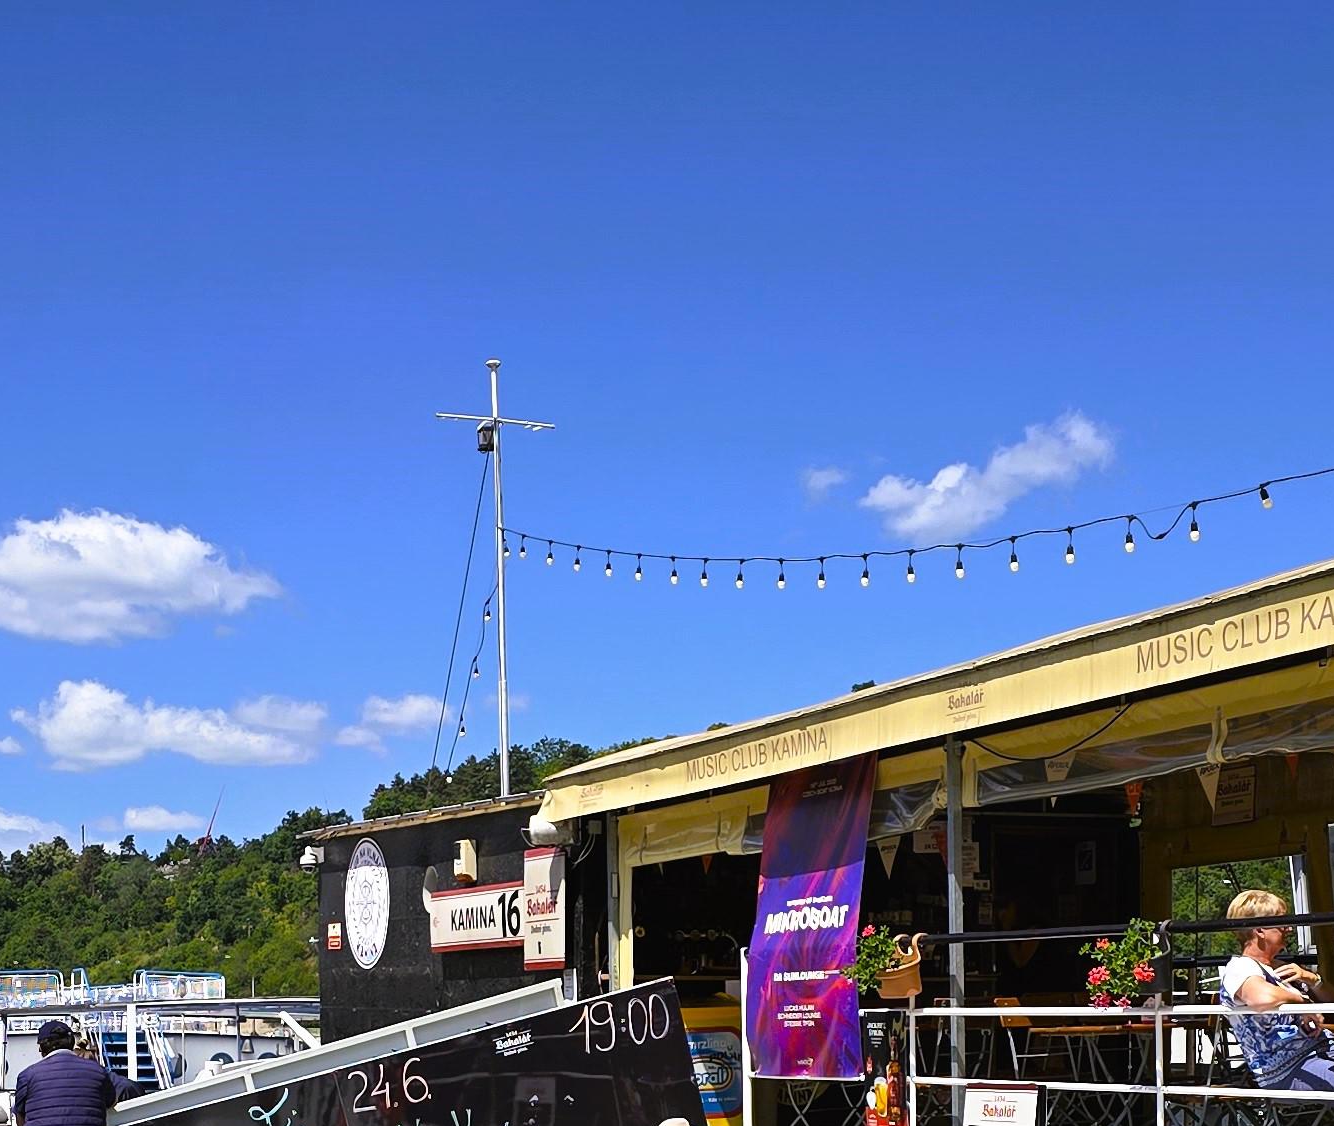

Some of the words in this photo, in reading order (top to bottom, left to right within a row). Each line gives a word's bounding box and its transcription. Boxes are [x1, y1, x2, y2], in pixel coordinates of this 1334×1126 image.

[1136, 628, 1214, 673] MUSIC
[1222, 607, 1291, 652] CLUB
[686, 752, 728, 783] MUSIC
[732, 741, 768, 772] CLUB
[770, 727, 828, 762] KAMINA
[451, 904, 497, 932] KAMINA
[498, 889, 521, 938] 16
[569, 993, 670, 1053] 19:00
[347, 1057, 432, 1113] 24.6.
